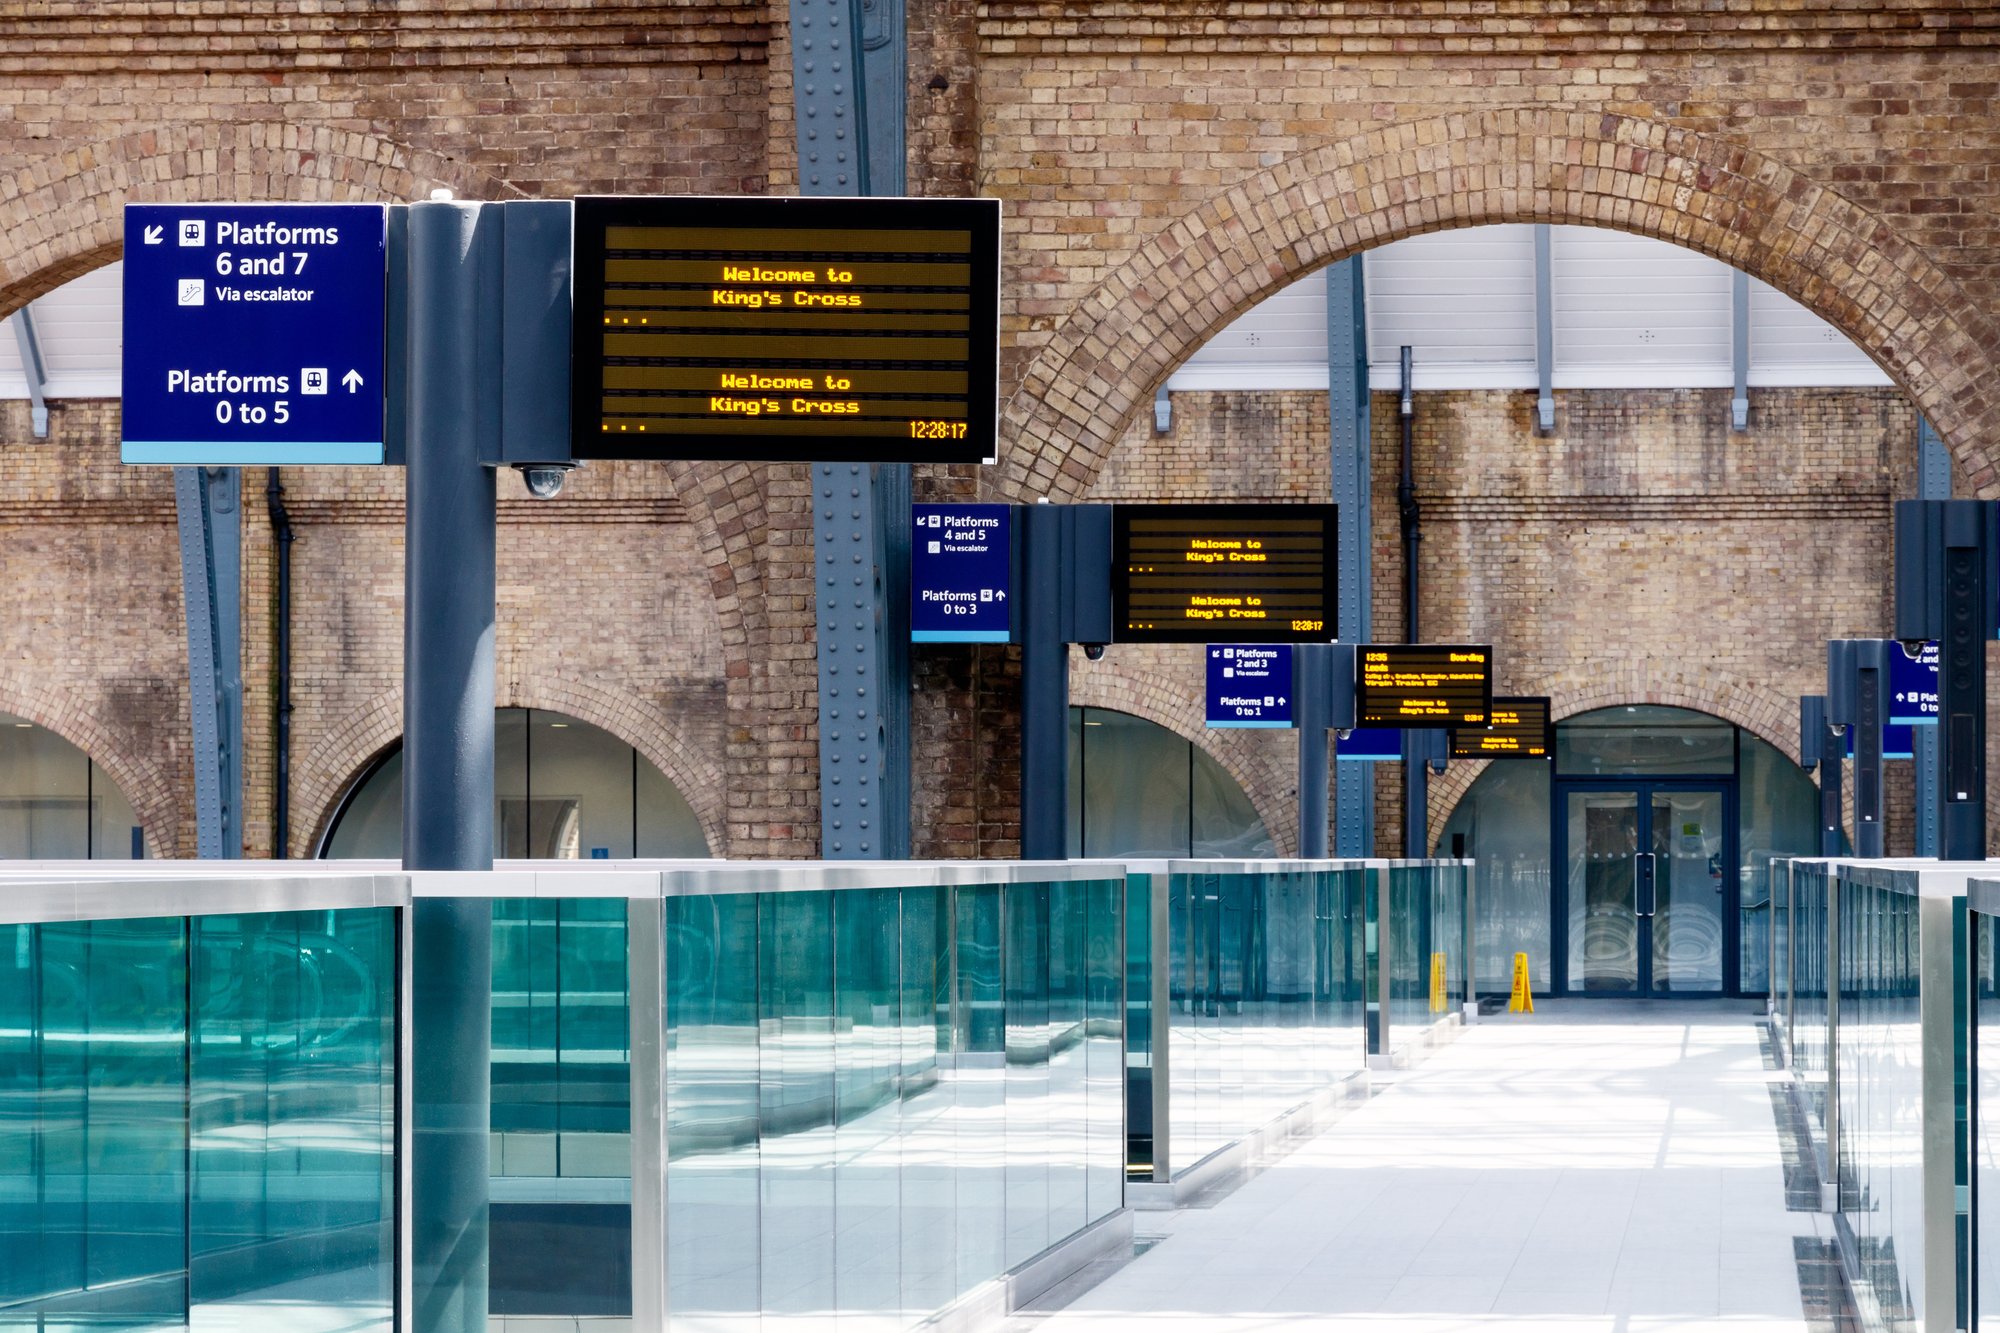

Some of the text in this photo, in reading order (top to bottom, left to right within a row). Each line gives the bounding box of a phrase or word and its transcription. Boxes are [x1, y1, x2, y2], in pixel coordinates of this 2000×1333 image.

[218, 222, 338, 244] Platforms
[217, 252, 308, 275] 6 and 7
[724, 267, 852, 282] Welcome to
[216, 287, 314, 301] Via escalator
[713, 290, 861, 308] King's Cross
[168, 370, 289, 393] Platforms
[722, 374, 850, 389] Welcome to
[216, 401, 289, 423] 0 to 5
[711, 398, 859, 415] King's Cross
[911, 421, 966, 438] 12:28:17
[945, 516, 998, 527] Platforms
[945, 530, 986, 540] 4 and 5
[1192, 540, 1261, 549] Welcome to
[1186, 552, 1266, 563] King's Cross
[923, 590, 976, 601] Platforms
[1192, 597, 1261, 605] Welcome to
[944, 604, 976, 614] 0 to 3
[1186, 609, 1266, 619] King's Cross
[1292, 620, 1323, 631] 12:28:17
[1236, 649, 1277, 658] Platforms
[1450, 653, 1484, 663] Boarding
[1923, 655, 1939, 663] and
[1237, 659, 1267, 668] 2 and 3
[1221, 697, 1261, 706] Platforms
[1921, 693, 1938, 702] Plat
[1236, 707, 1261, 716] 0 to 1
[1921, 703, 1939, 712] 0 to
